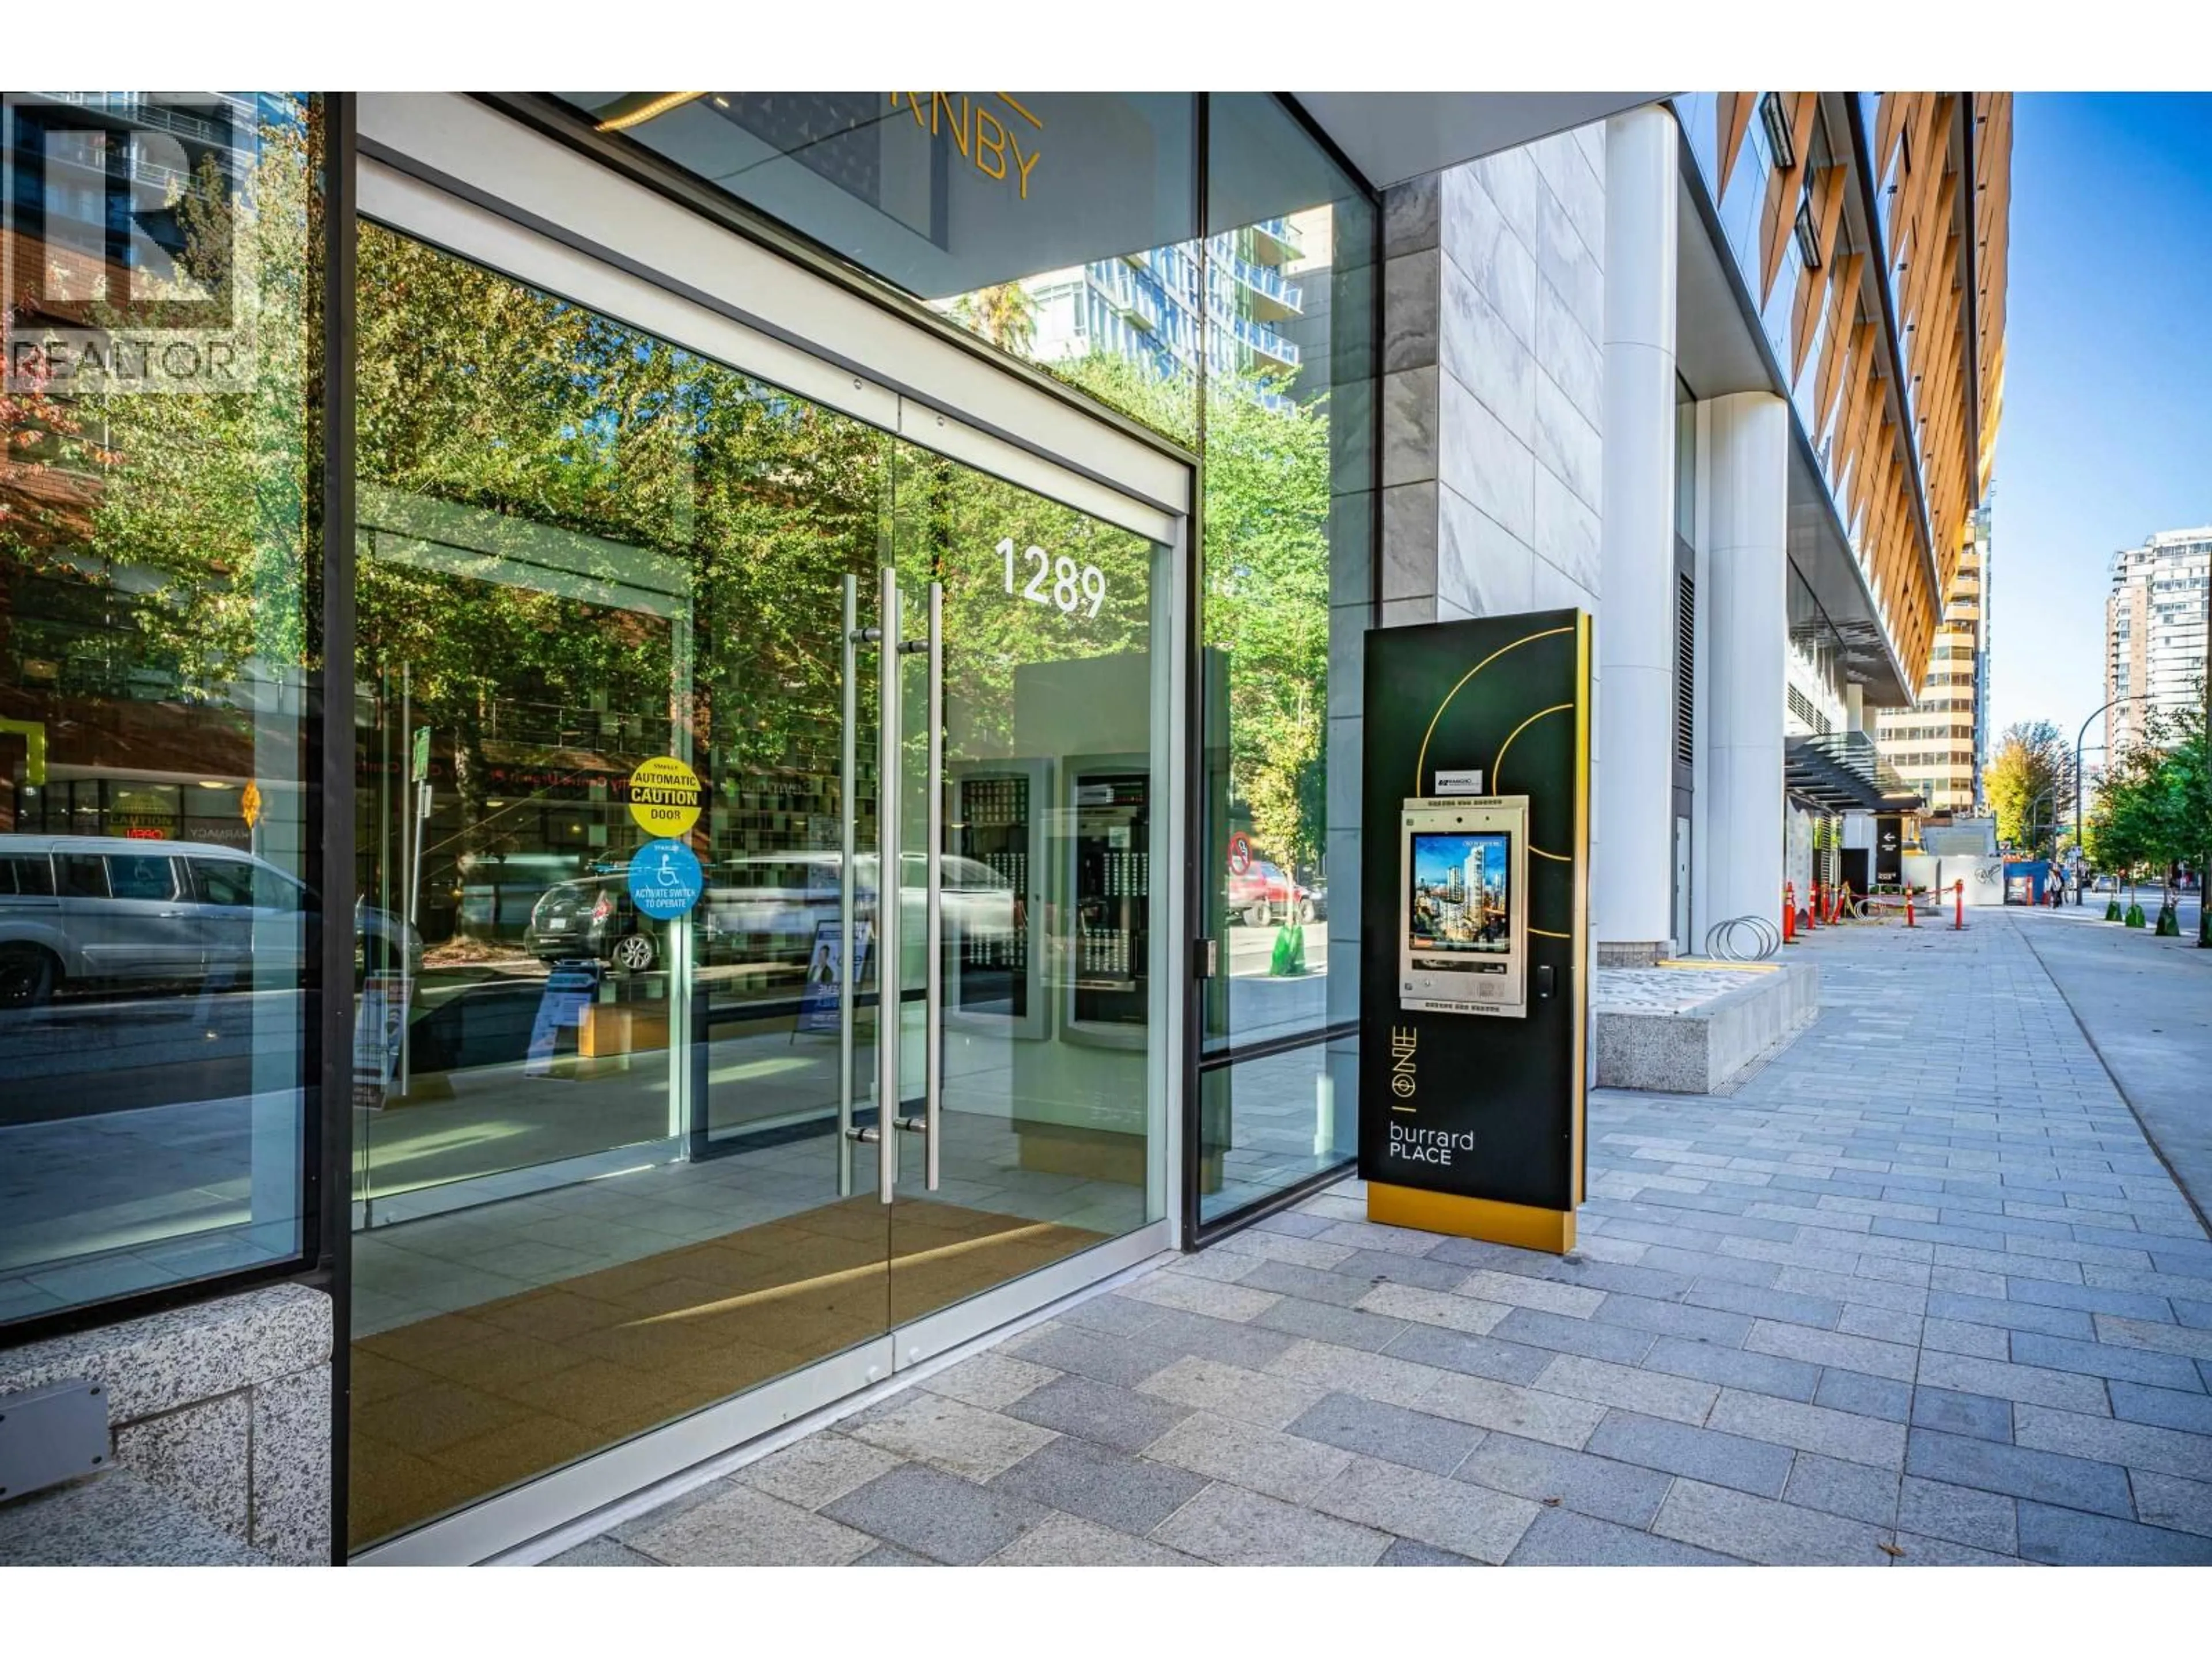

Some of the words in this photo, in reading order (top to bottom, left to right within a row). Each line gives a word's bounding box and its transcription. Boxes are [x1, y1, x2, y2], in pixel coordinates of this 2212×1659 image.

[995, 537, 1105, 619] 1289
[635, 772, 696, 786] AUTOMATIC
[631, 787, 698, 805] CAUTION
[651, 808, 681, 819] DOOR
[645, 898, 655, 908] TO
[656, 898, 687, 908] OPERATE
[1389, 1121, 1474, 1151] burrard
[1389, 1142, 1452, 1165] PLACE
